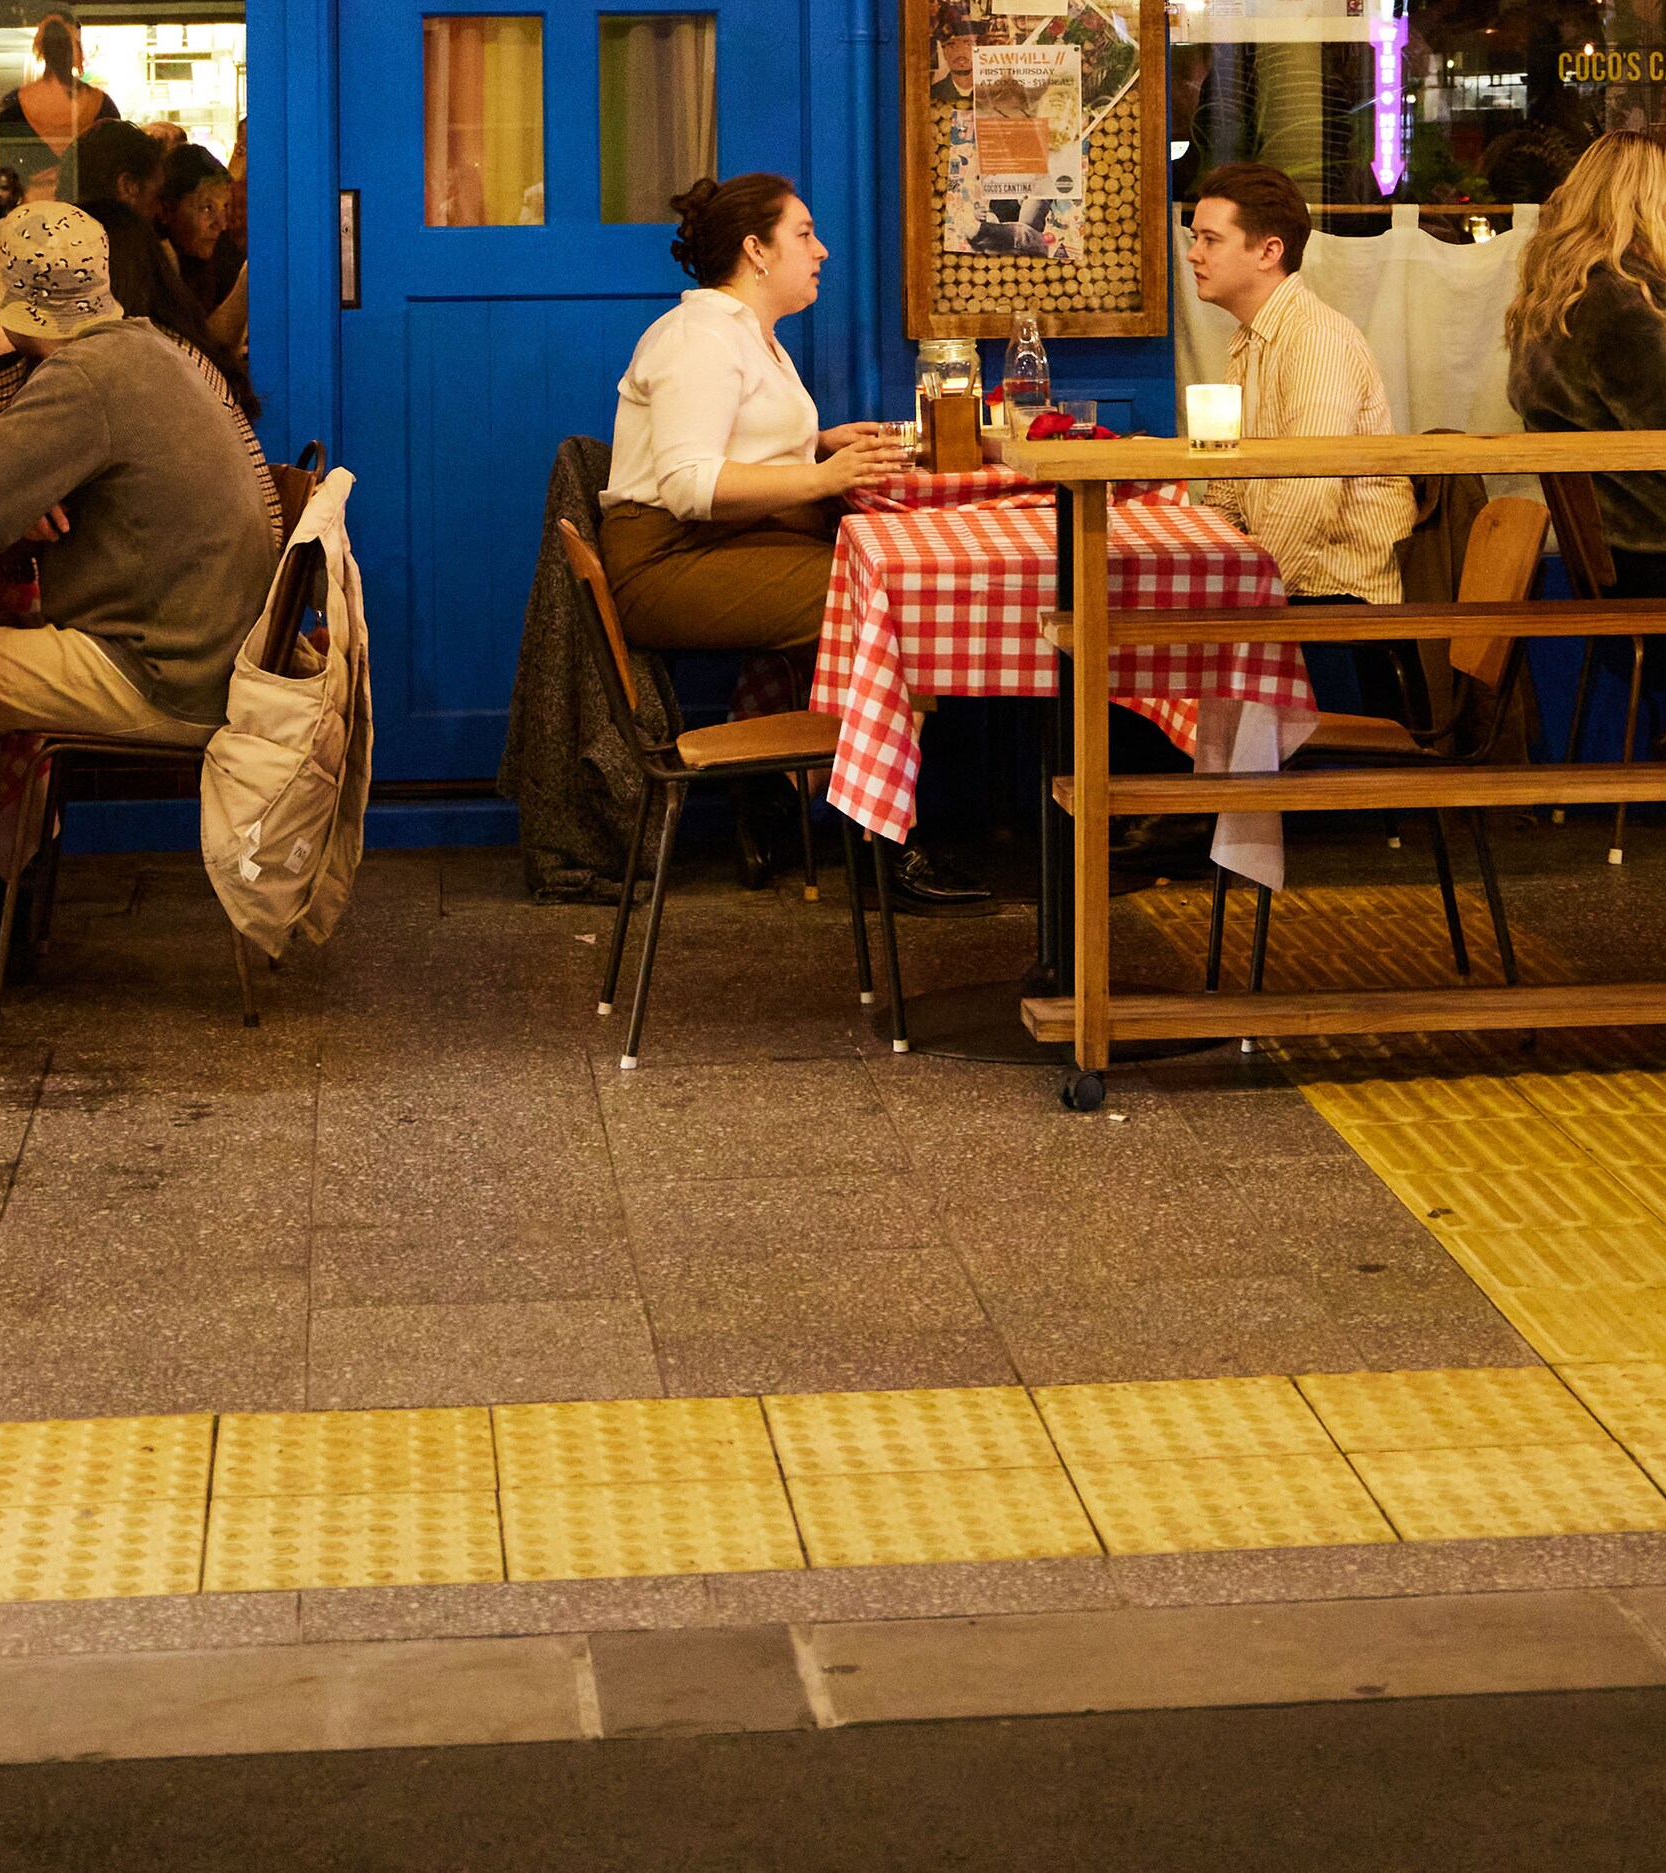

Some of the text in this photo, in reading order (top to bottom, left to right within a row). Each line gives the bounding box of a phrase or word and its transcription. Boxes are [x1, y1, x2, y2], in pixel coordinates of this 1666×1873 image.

[979, 52, 1051, 65] SAWMILL
[979, 68, 1055, 76] FIRST THURSDAY
[1558, 51, 1641, 82] COCO'S
[983, 183, 1032, 194] COCO'S CANTINA
